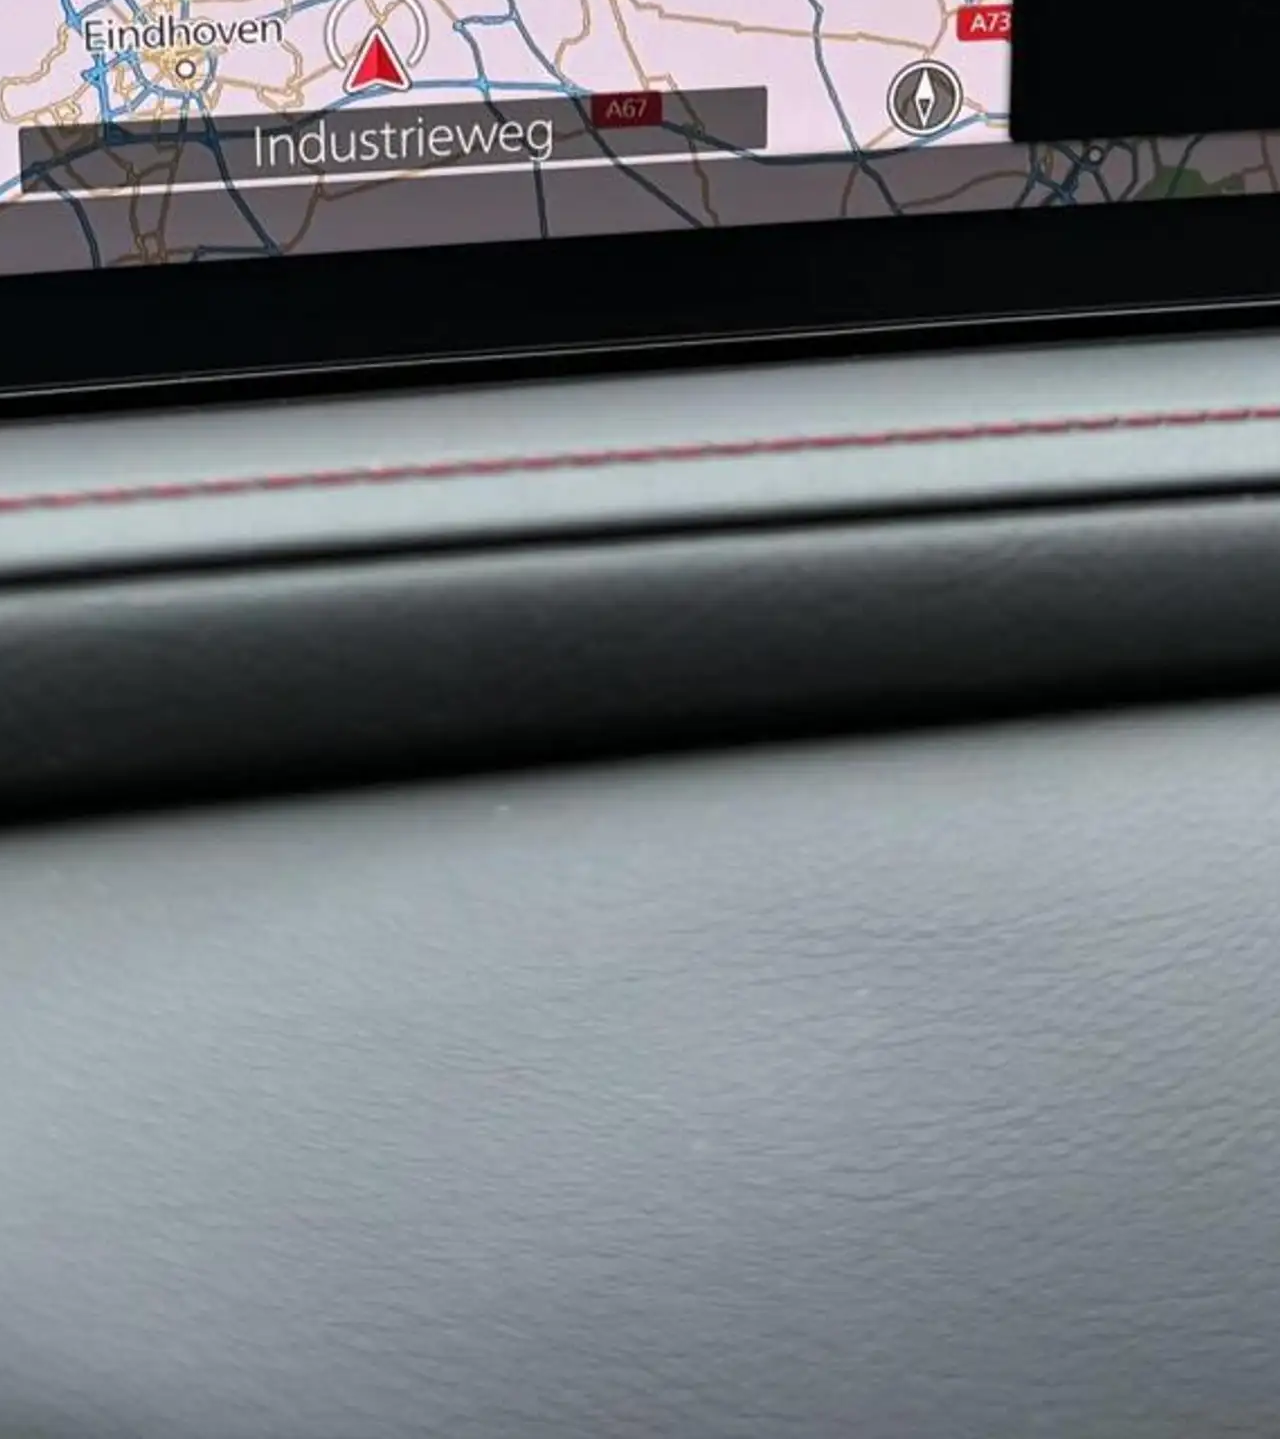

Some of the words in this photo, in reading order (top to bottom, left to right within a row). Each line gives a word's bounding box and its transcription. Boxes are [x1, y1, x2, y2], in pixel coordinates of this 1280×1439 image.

[85, 15, 283, 52] Eindhoven
[970, 11, 1012, 32] A73
[606, 98, 647, 118] A67
[254, 117, 554, 162] Industrieweg
